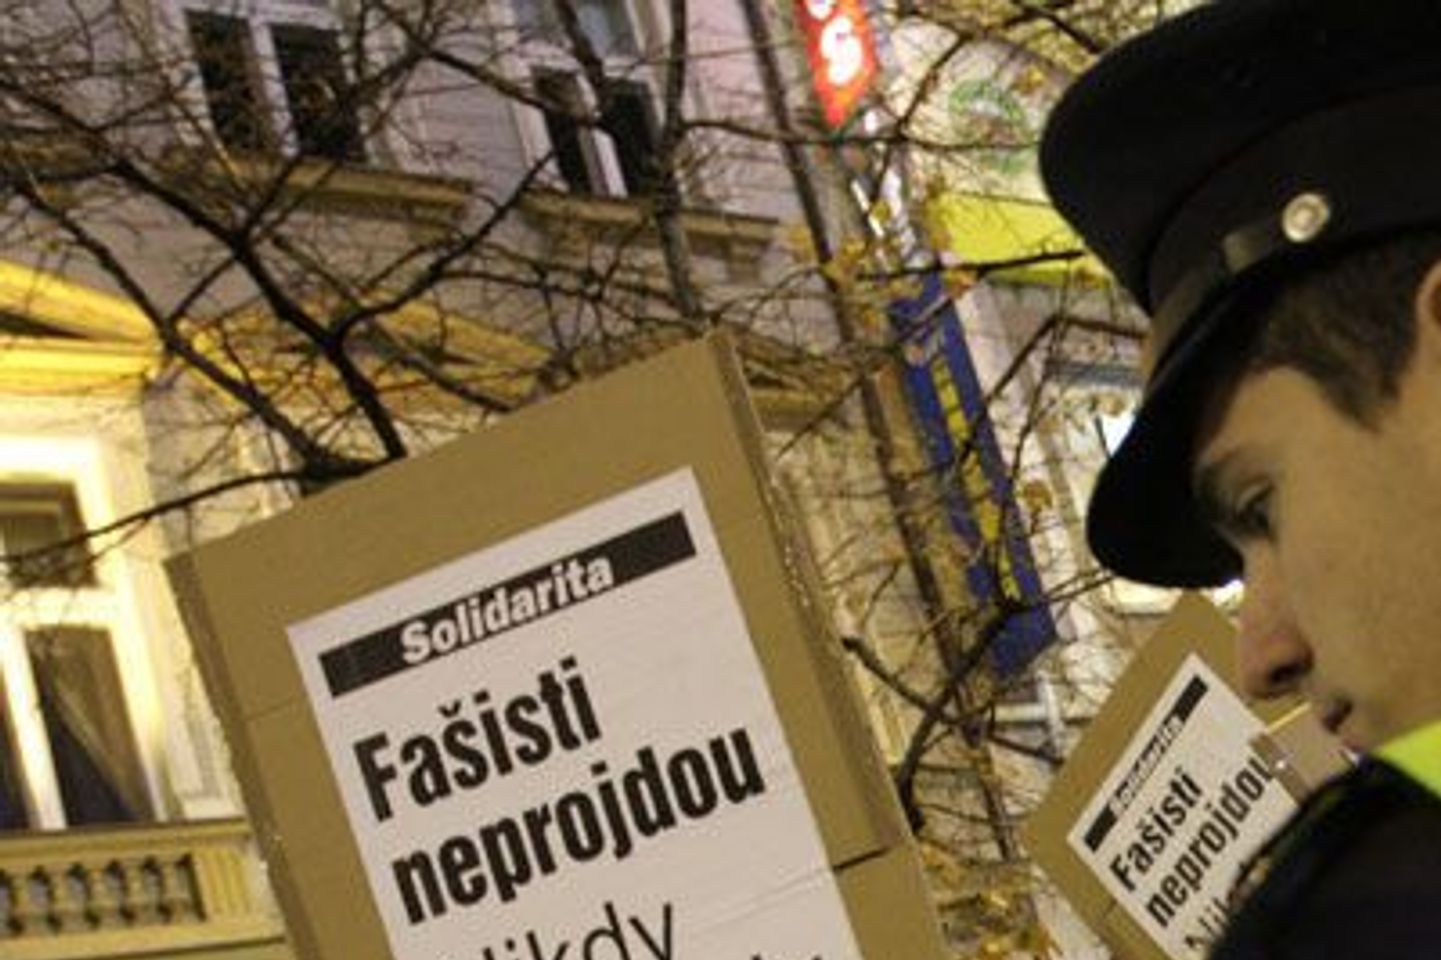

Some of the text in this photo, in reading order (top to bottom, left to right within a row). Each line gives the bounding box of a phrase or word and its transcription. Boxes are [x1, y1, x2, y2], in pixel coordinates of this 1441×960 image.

[400, 554, 615, 665] Solidarita
[353, 655, 602, 822] Fašisti
[391, 727, 767, 926] neprojdou
[1109, 765, 1204, 893] Fašisti
